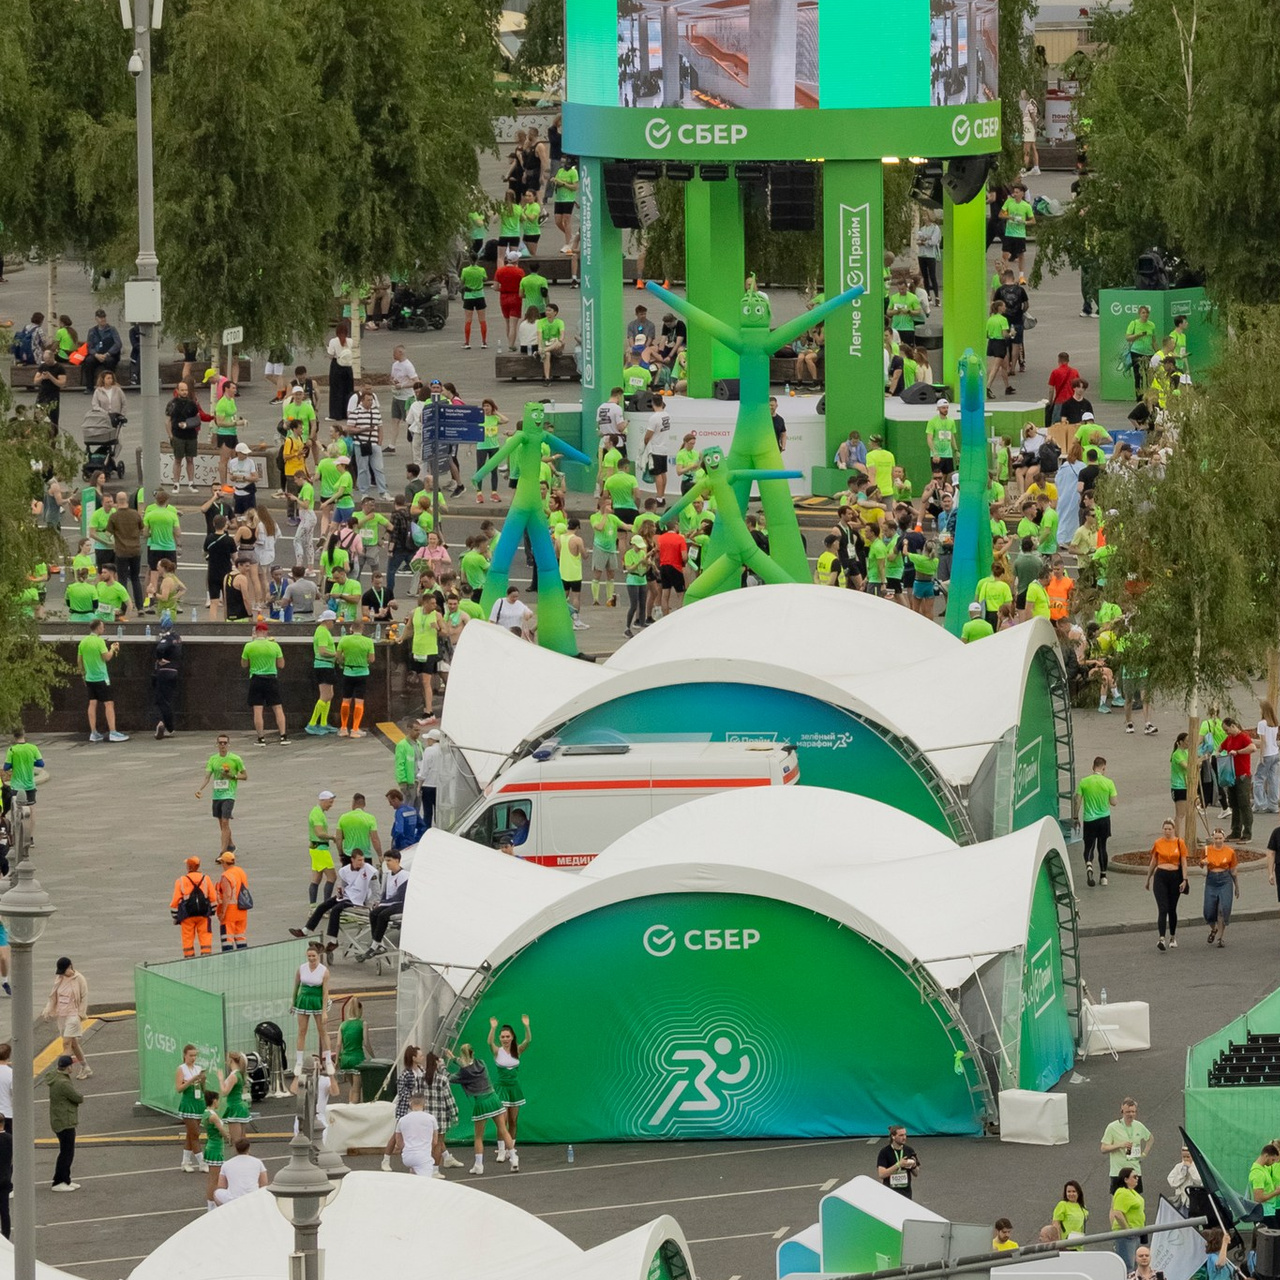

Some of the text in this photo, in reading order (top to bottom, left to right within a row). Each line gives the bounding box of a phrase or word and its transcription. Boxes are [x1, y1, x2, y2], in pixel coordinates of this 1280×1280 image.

[678, 124, 748, 145] СБЕР
[973, 116, 999, 139] СБЕР
[848, 216, 864, 268] Прайм
[1124, 304, 1152, 314] СБР
[850, 310, 862, 357] Легче
[796, 740, 833, 749] марафон
[800, 732, 836, 740] зелёный
[683, 928, 761, 951] СБЕР
